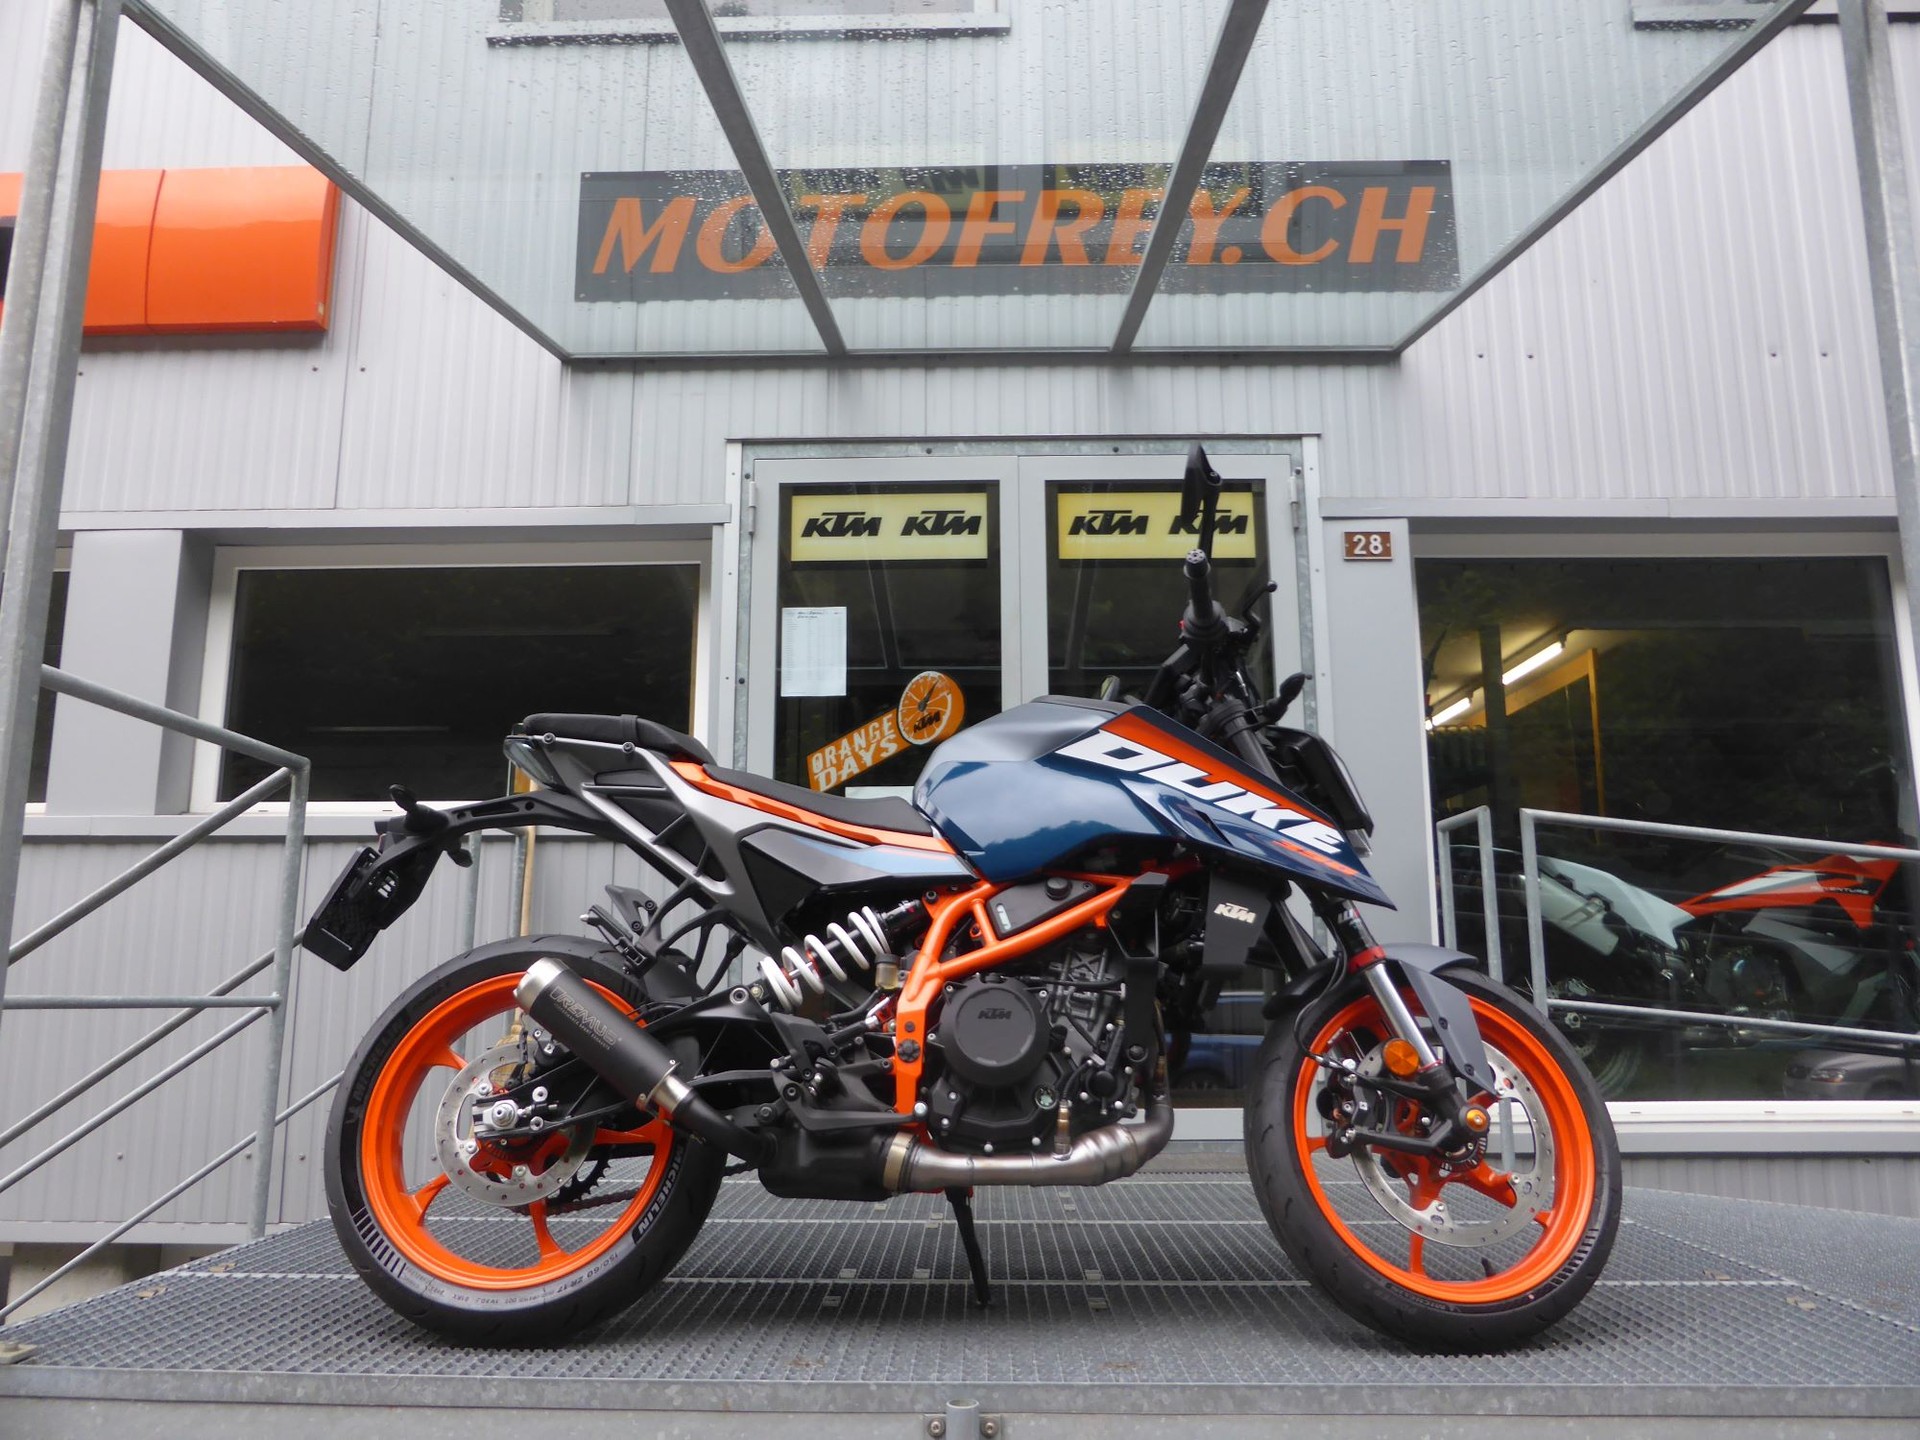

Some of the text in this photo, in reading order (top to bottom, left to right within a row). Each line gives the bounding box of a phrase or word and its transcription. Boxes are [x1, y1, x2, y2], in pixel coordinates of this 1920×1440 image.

[592, 186, 1437, 274] MOTOFREY.CH
[801, 510, 981, 537] KTM KTM
[1068, 509, 1248, 535] KTM KM
[1353, 534, 1383, 555] 28
[913, 711, 941, 734] KTM
[811, 713, 894, 773] ORANGE
[814, 733, 898, 792] DAYS
[1054, 729, 1346, 855] DUKE
[1213, 902, 1256, 924] KTM
[558, 994, 618, 1046] REMUS
[977, 1007, 1012, 1020] KTM
[638, 1145, 685, 1235] MICHELIN
[587, 1251, 619, 1278] 150/60
[556, 1282, 568, 1294] 17
